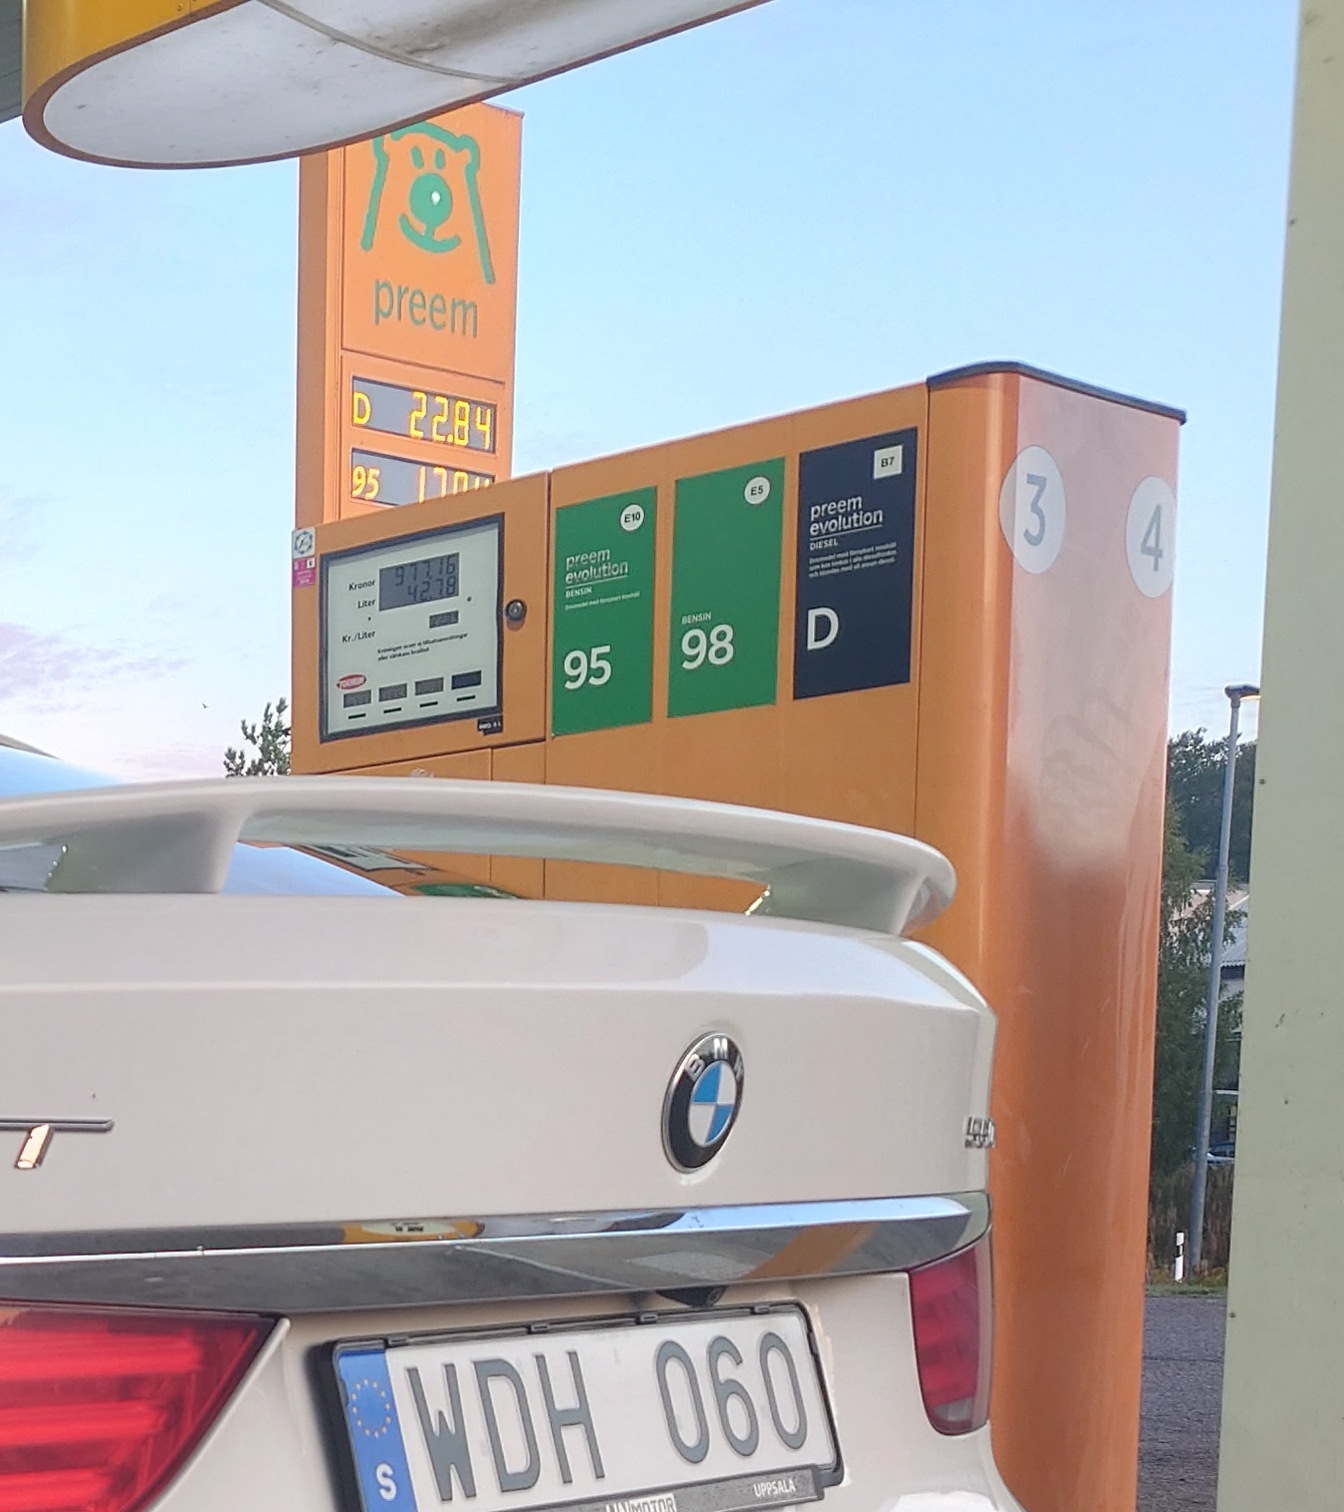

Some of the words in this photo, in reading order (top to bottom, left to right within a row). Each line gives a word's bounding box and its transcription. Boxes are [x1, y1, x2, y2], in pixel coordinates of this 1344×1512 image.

[374, 278, 478, 338] preem
[353, 391, 371, 425] D
[410, 391, 492, 449] 22.84
[881, 457, 894, 468] B7
[352, 466, 380, 500] 95
[751, 485, 764, 495] E5
[624, 511, 640, 523] E10
[810, 496, 862, 521] preem
[1023, 473, 1047, 547] 3
[810, 510, 883, 535] evolution
[810, 538, 838, 551] DIESEL
[1140, 503, 1164, 571] 4
[566, 549, 610, 571] preem
[565, 562, 628, 584] evolution
[348, 580, 375, 591] Kronor
[565, 586, 592, 598] BENSIN
[358, 599, 375, 609] Liter
[682, 612, 712, 624] BENSIN
[807, 607, 839, 650] D
[342, 631, 375, 643] Kr./Liter
[681, 624, 734, 670] 98
[564, 645, 611, 690] 95
[405, 1350, 606, 1502] WDH
[655, 1331, 809, 1465] 060
[377, 1462, 397, 1501] S
[754, 1479, 796, 1499] UPPSALA
